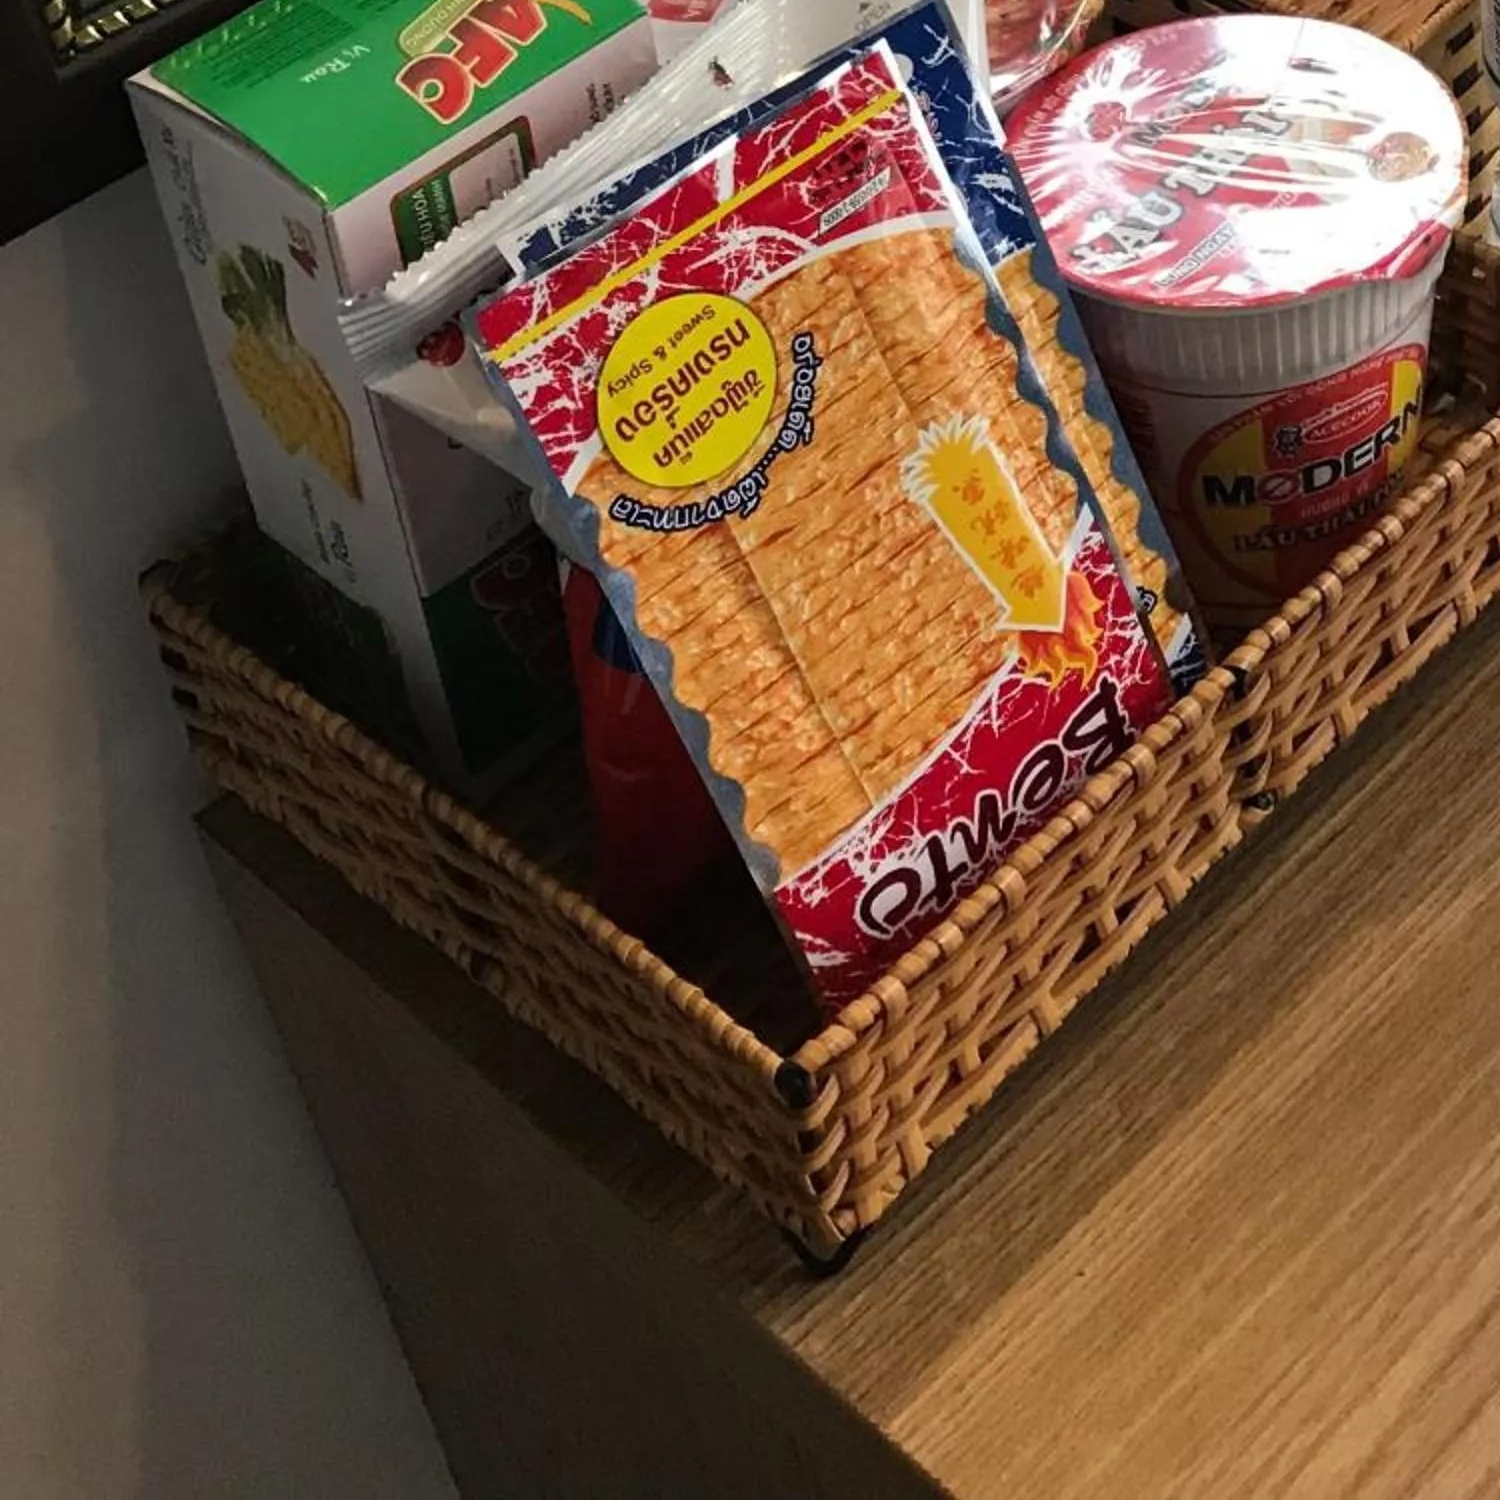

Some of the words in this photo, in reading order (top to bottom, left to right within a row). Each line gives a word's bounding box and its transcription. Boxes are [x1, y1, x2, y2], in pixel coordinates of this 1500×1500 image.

[605, 358, 653, 397] Spicy
[615, 318, 752, 443] ทรงเครื่อง
[668, 303, 717, 349] Sweet
[1203, 383, 1425, 509] MODERN
[855, 675, 1136, 940] Bento
